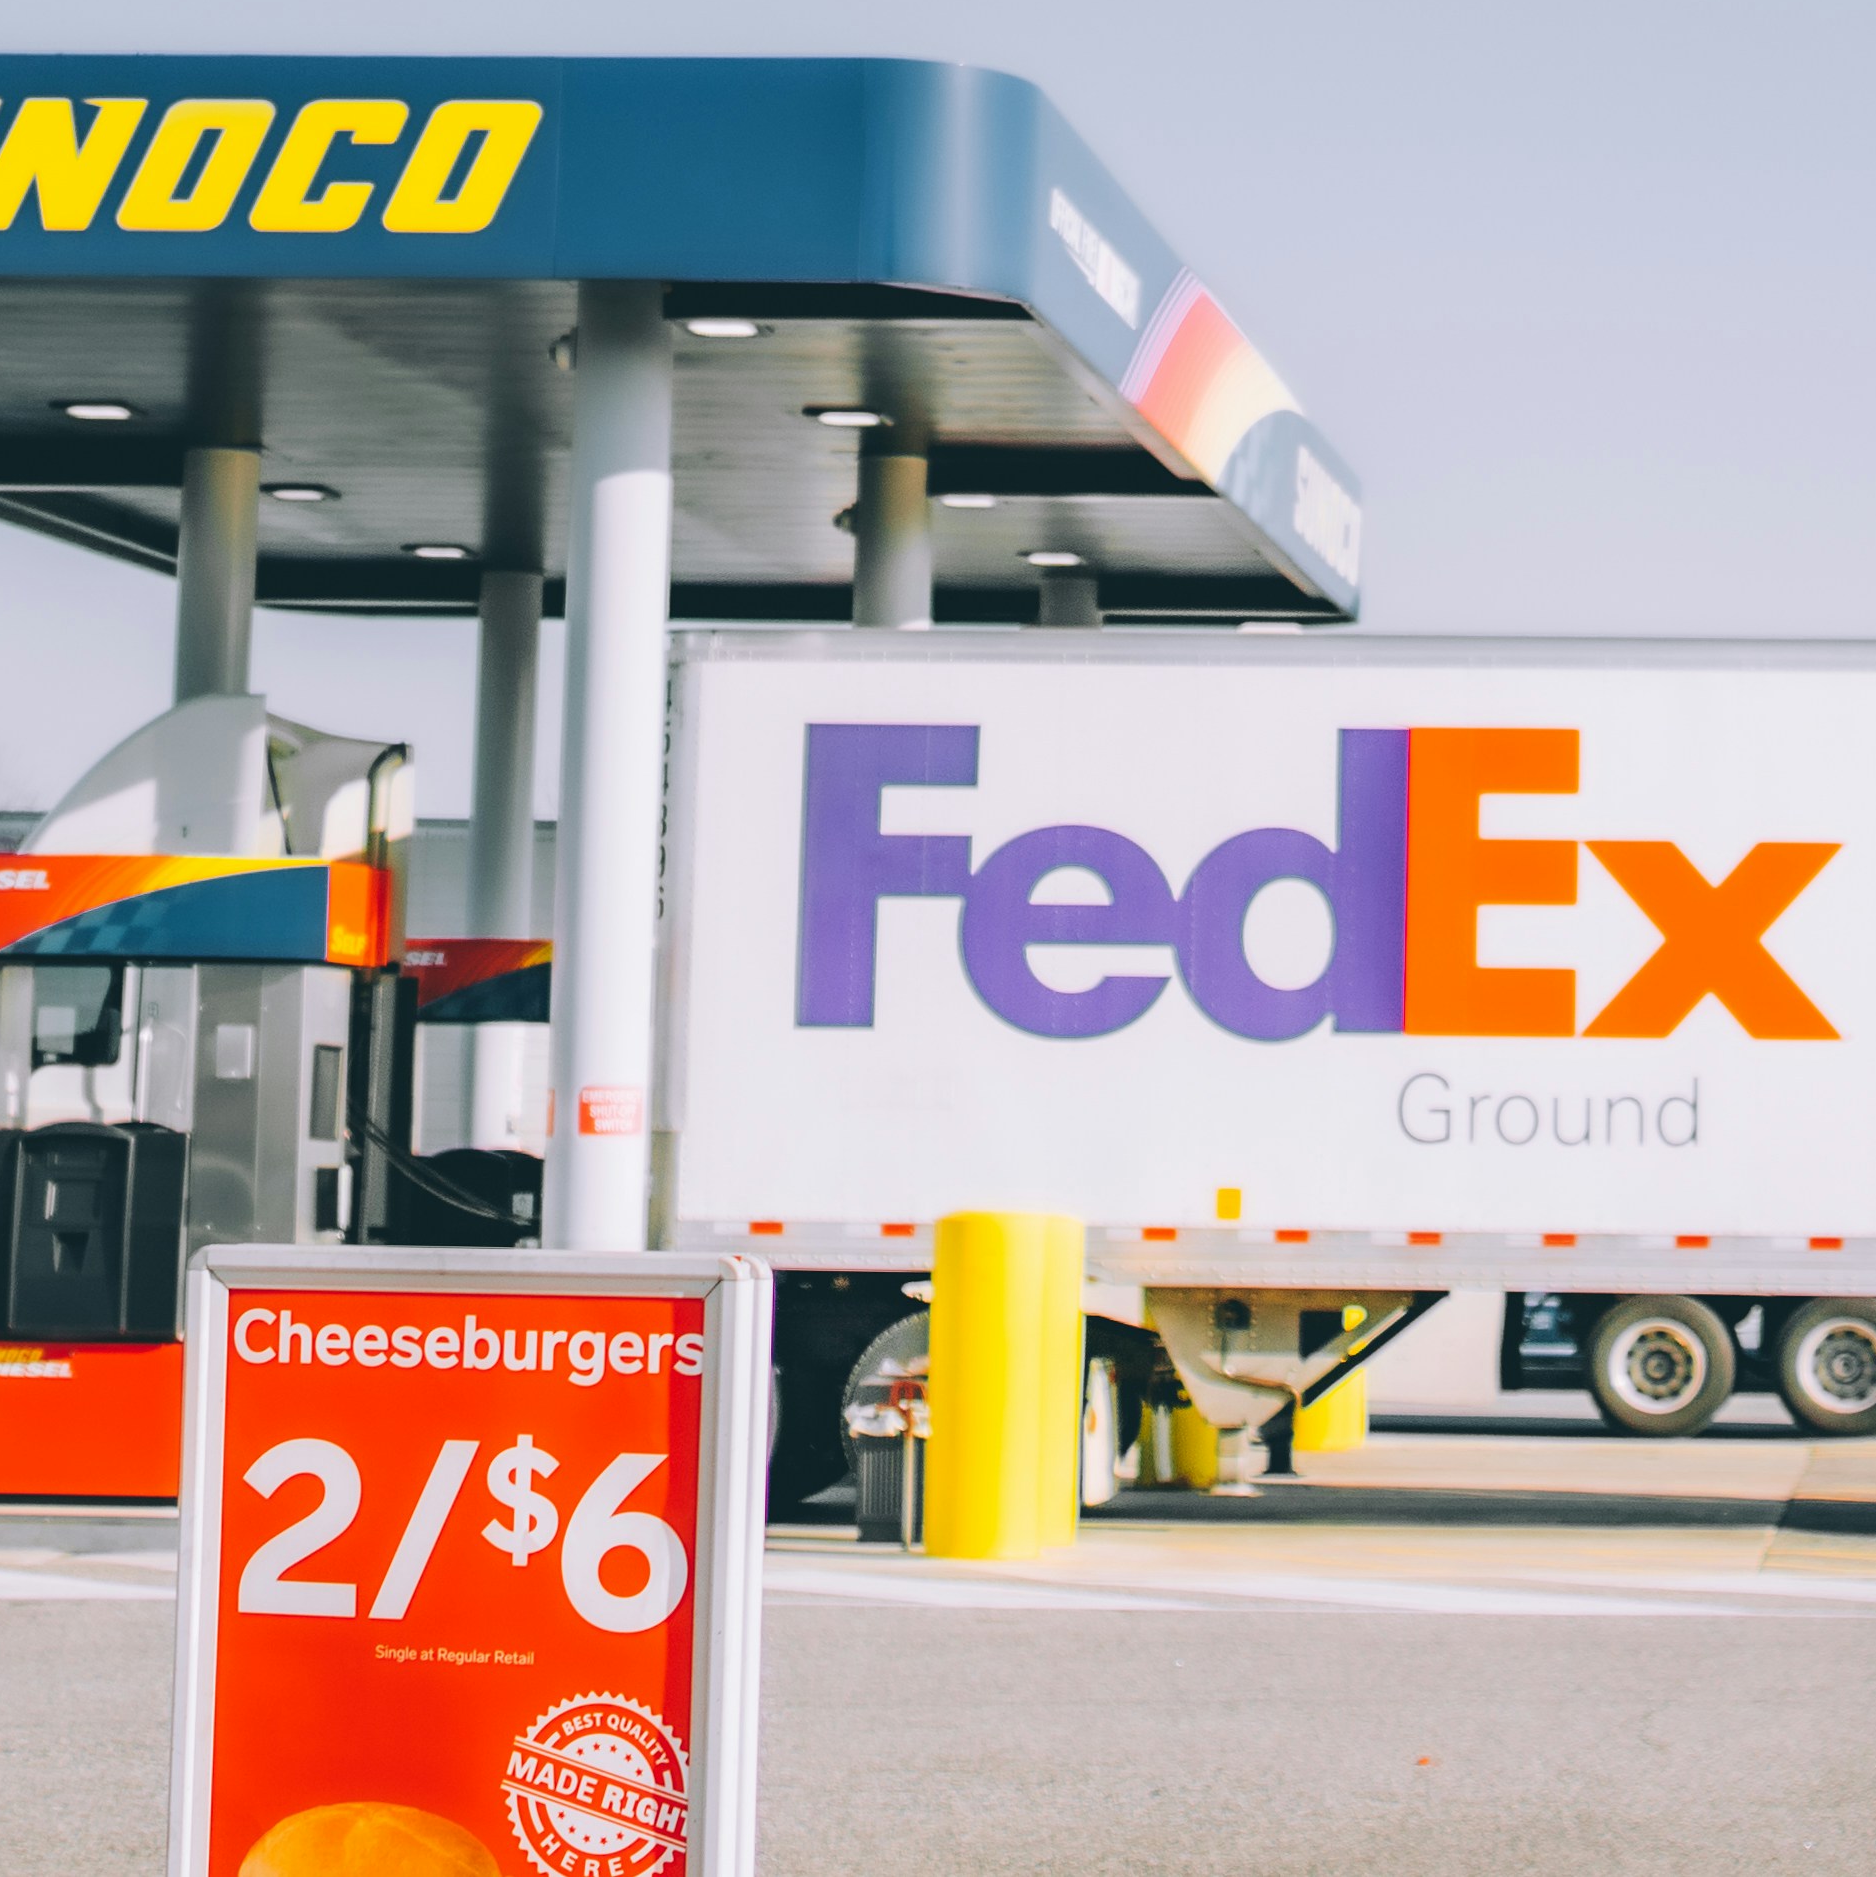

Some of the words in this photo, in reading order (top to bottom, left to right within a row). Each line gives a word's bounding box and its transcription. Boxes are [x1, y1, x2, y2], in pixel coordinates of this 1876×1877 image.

[794, 721, 1844, 1042] FedEx
[1396, 1071, 1701, 1148] Ground
[234, 1307, 705, 1387] Cheeseburgers
[375, 1643, 417, 1663] Single
[420, 1647, 434, 1661] at
[437, 1647, 491, 1666] Regular
[494, 1649, 535, 1665] Retail
[561, 1712, 603, 1736] BEST
[606, 1713, 670, 1766] QUALITY
[506, 1750, 598, 1804] MADE
[540, 1833, 624, 1877] HERE
